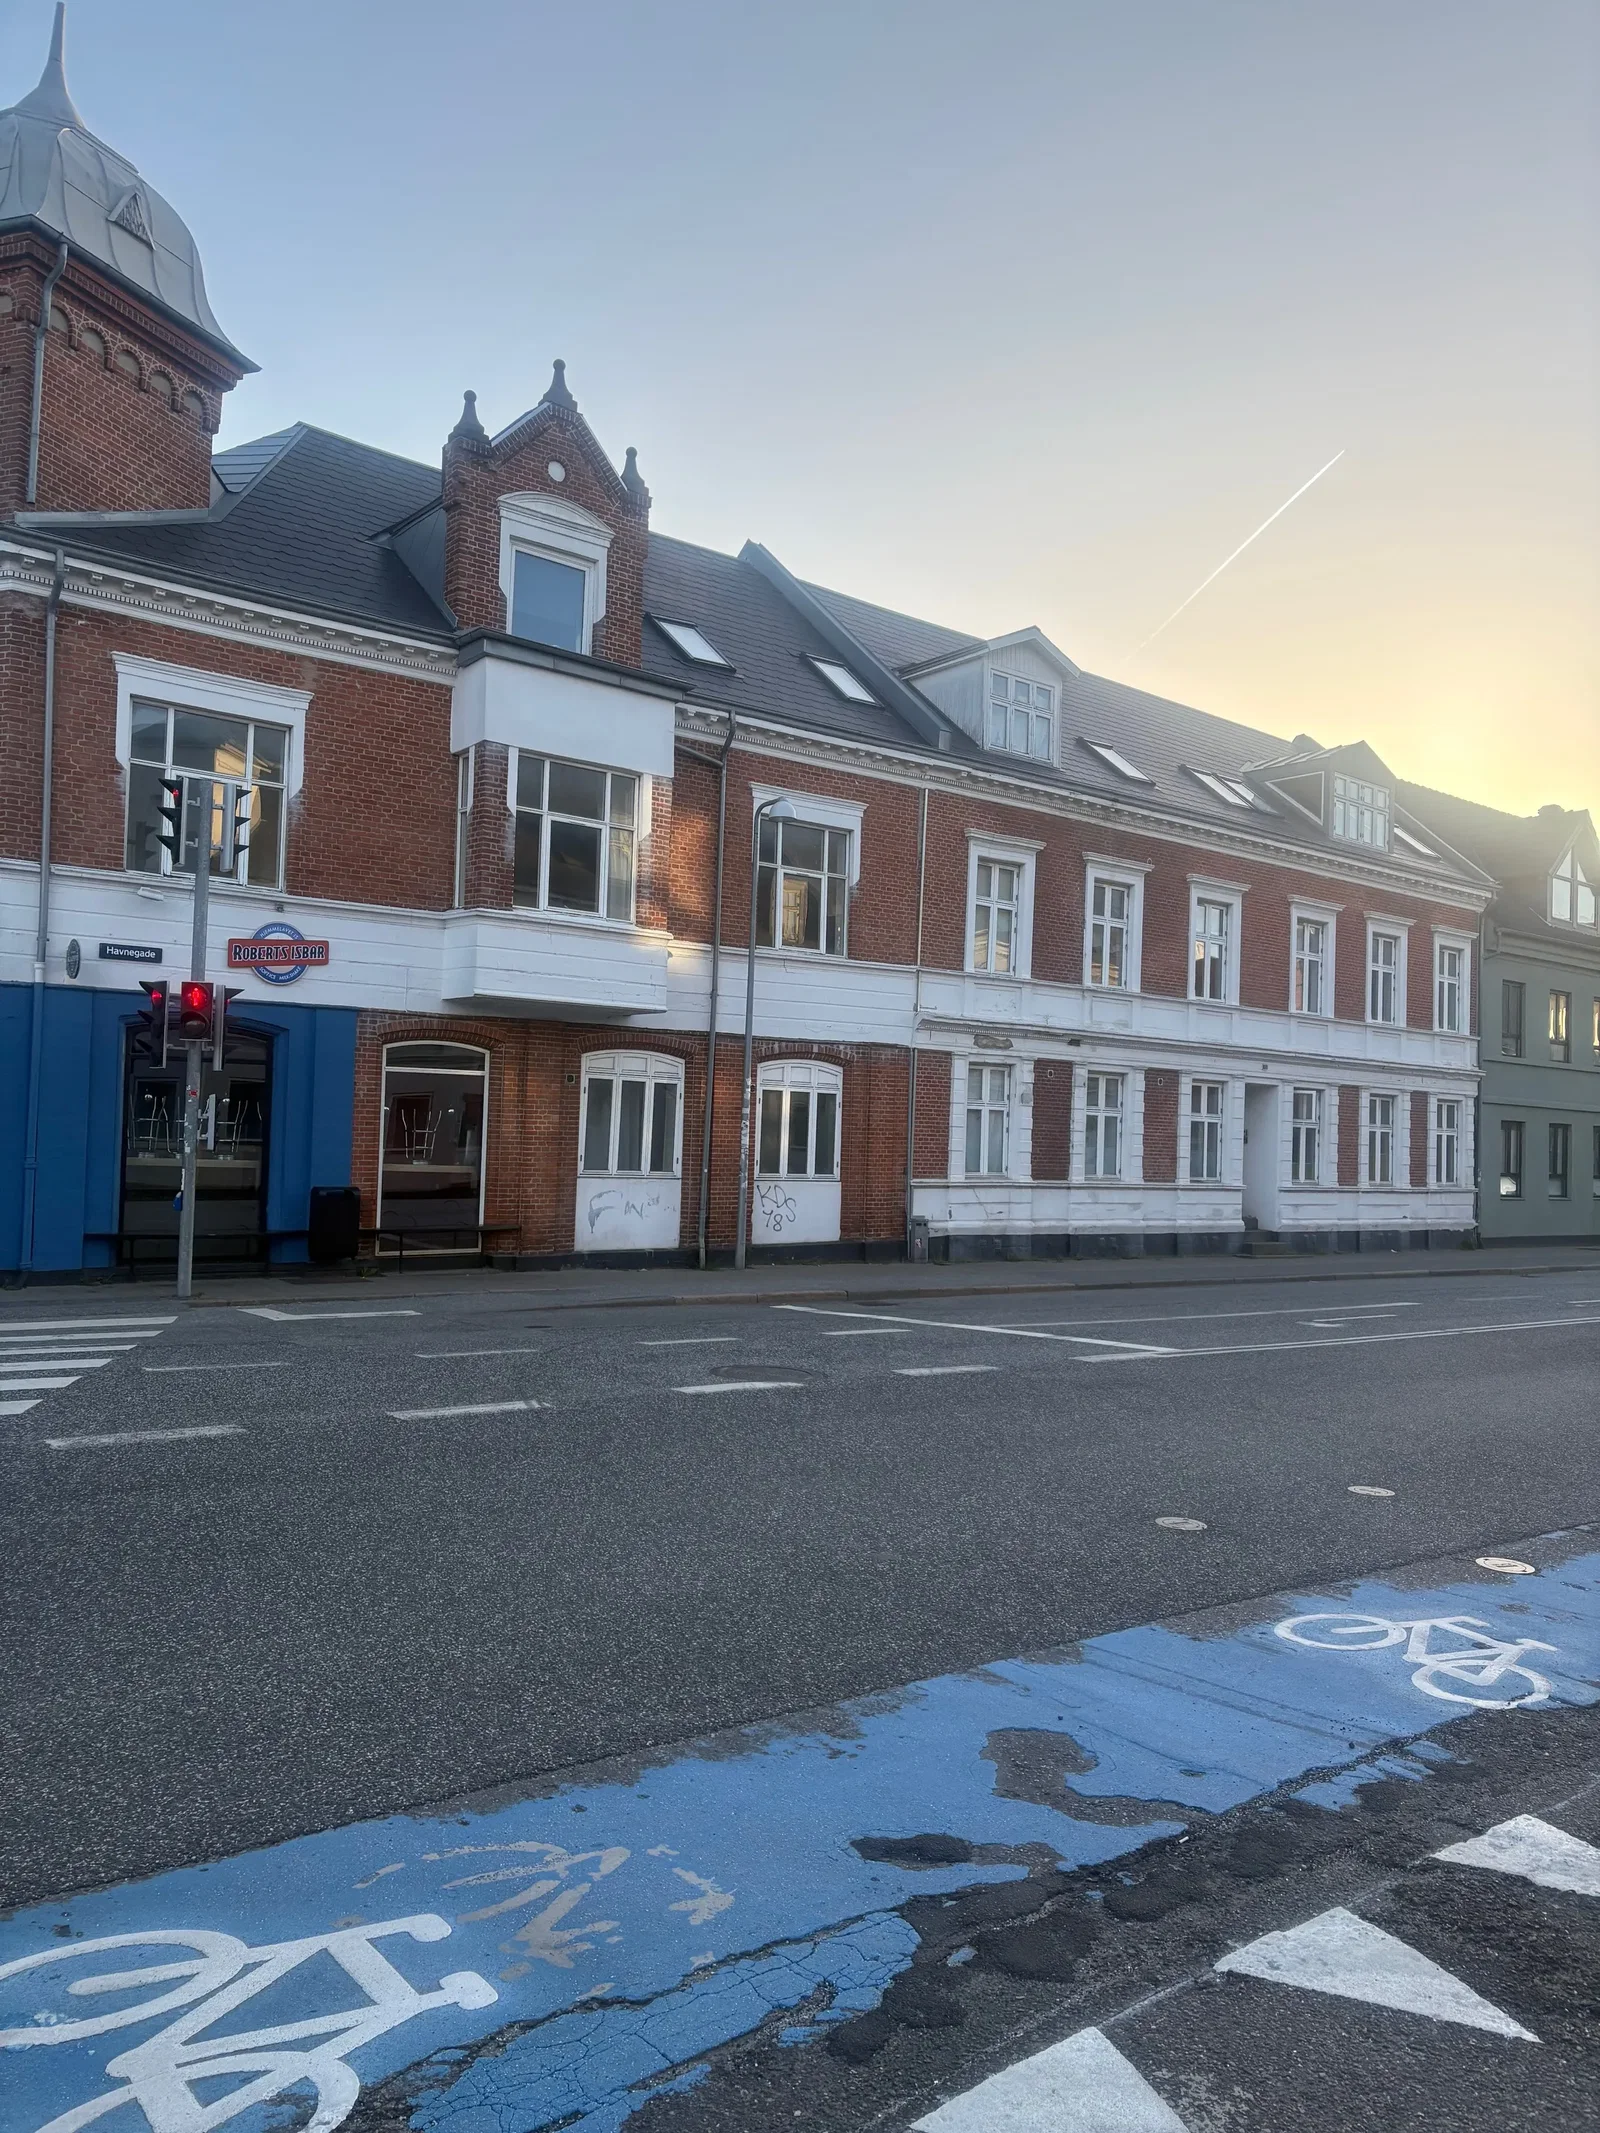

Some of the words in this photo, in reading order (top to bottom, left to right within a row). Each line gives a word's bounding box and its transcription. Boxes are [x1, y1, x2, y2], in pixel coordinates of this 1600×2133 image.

[106, 946, 156, 958] Havnegade
[233, 944, 289, 961] ROBERTS
[290, 944, 325, 960] ISBAR
